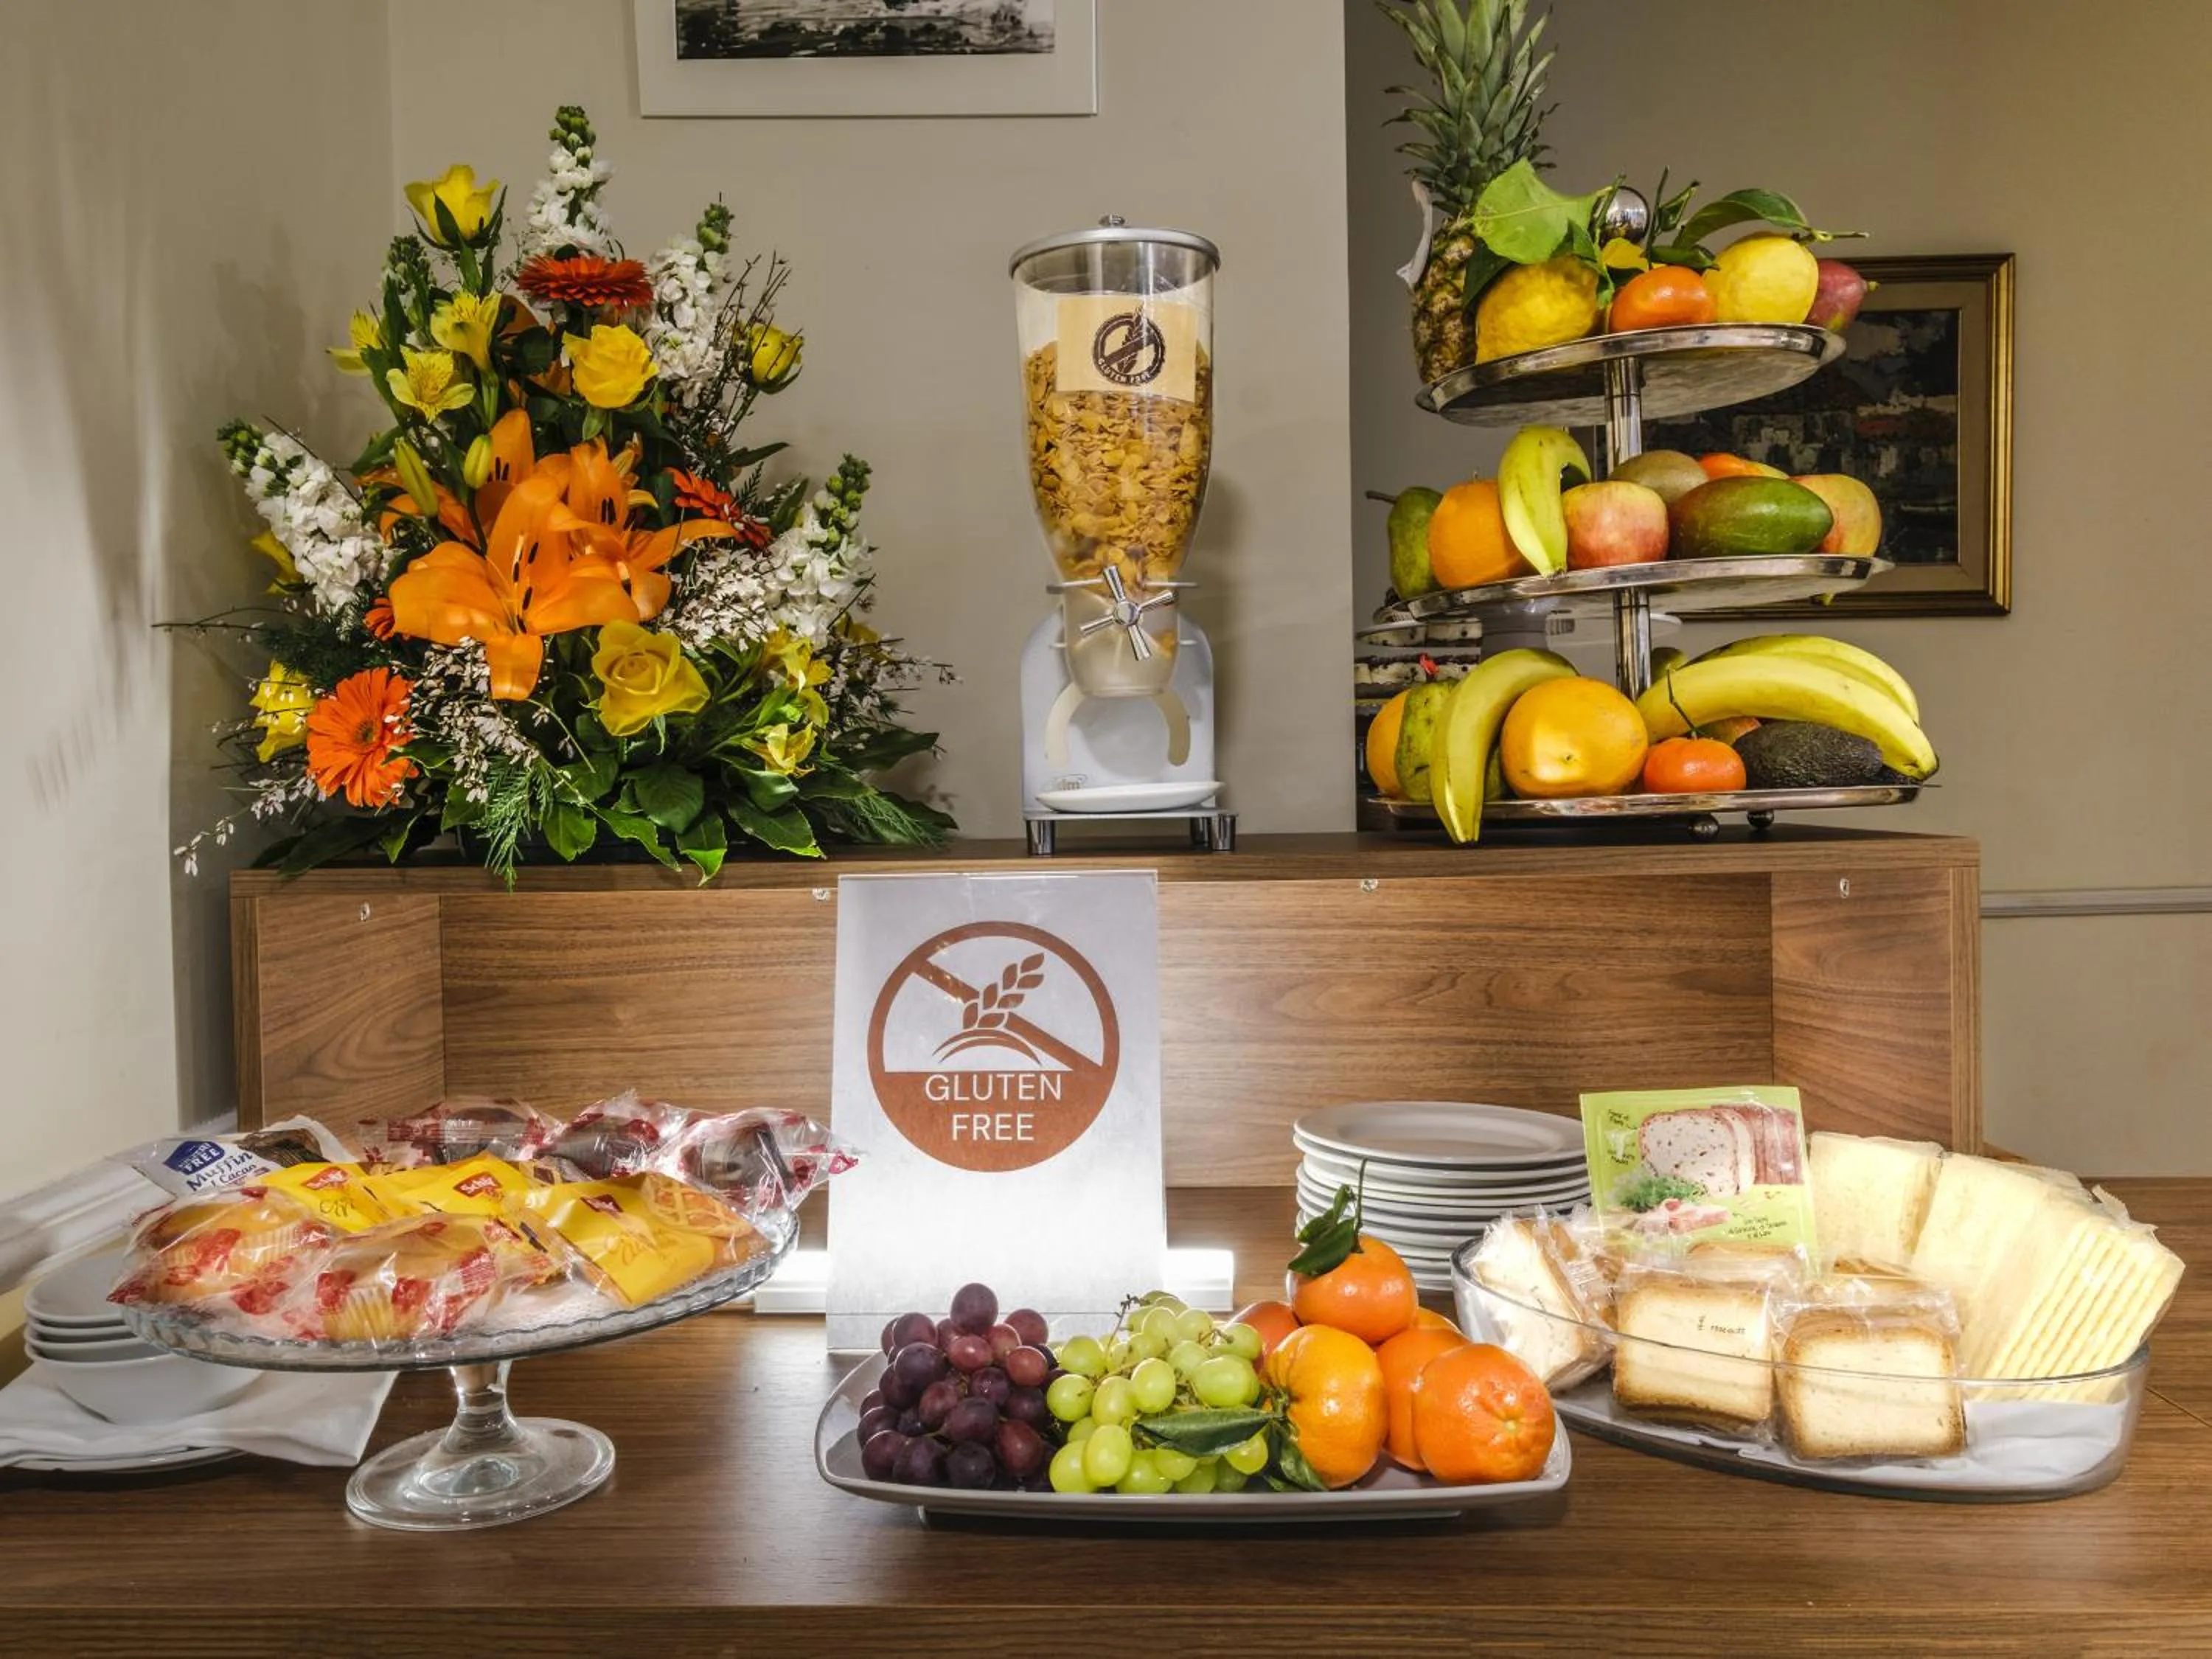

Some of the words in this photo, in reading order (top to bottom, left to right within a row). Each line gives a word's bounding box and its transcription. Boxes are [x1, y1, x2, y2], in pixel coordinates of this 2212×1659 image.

[925, 1074, 1061, 1101] GLUTEN
[952, 1113, 1034, 1141] FREE
[184, 1148, 220, 1172] FREE
[187, 1152, 253, 1192] Muffin
[220, 1164, 257, 1183] Cacao
